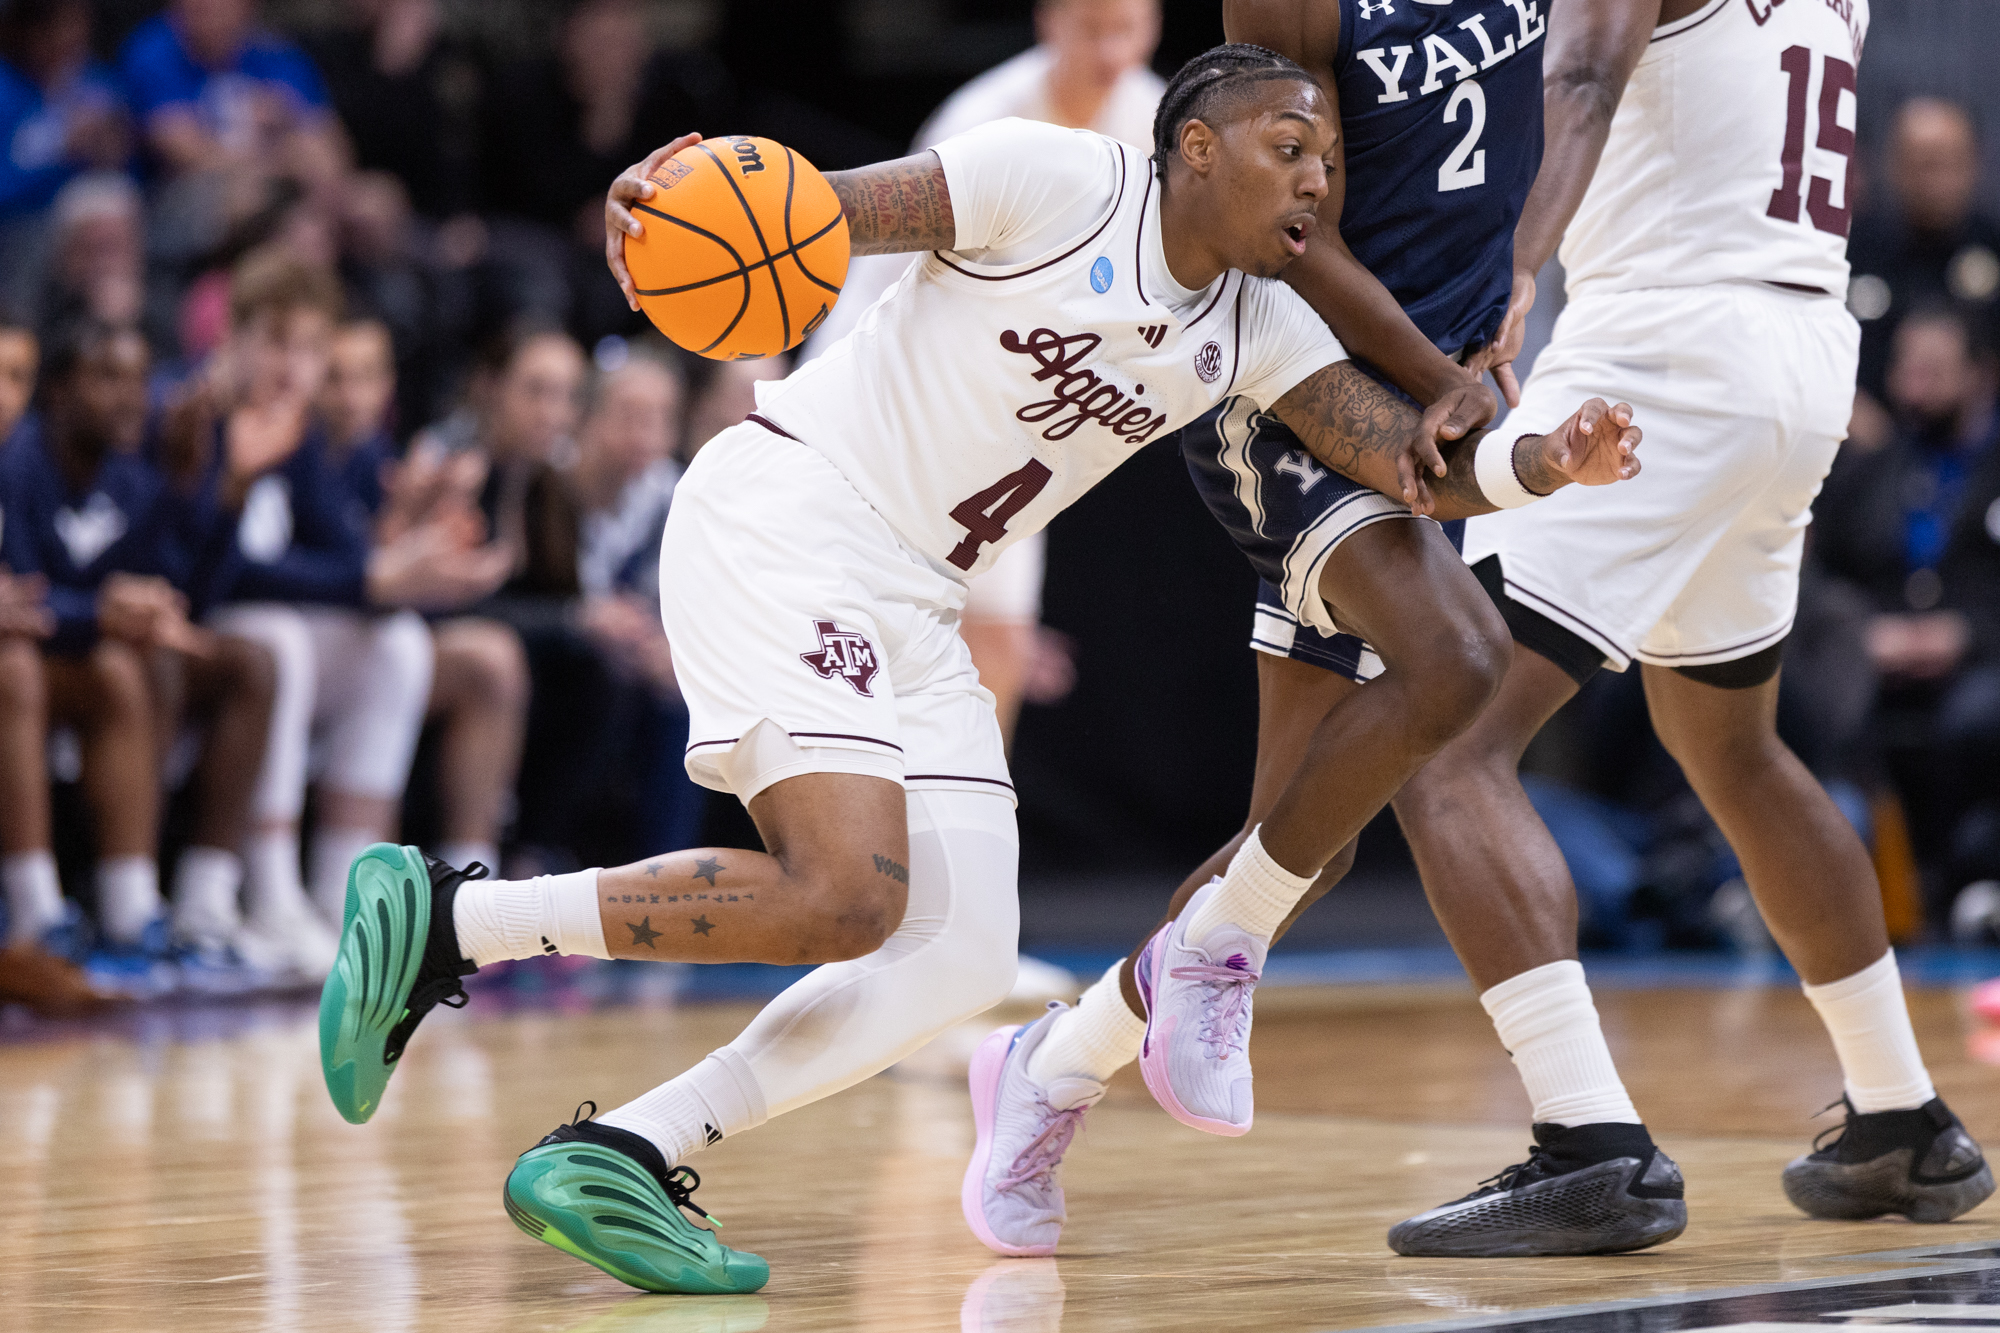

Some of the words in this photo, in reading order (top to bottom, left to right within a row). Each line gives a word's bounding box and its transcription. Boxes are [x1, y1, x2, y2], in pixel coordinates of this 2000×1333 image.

[1356, 0, 1546, 103] YALE
[1438, 78, 1487, 192] 2
[1766, 44, 1857, 240] 15
[874, 182, 895, 225] Rush
[897, 189, 907, 212] PLACE
[926, 178, 939, 207] WHILE
[1093, 266, 1109, 291] NCAA
[1202, 343, 1221, 373] SEC
[1000, 327, 1167, 444] Aggies
[1273, 449, 1328, 495] Y
[945, 457, 1054, 572] 4
